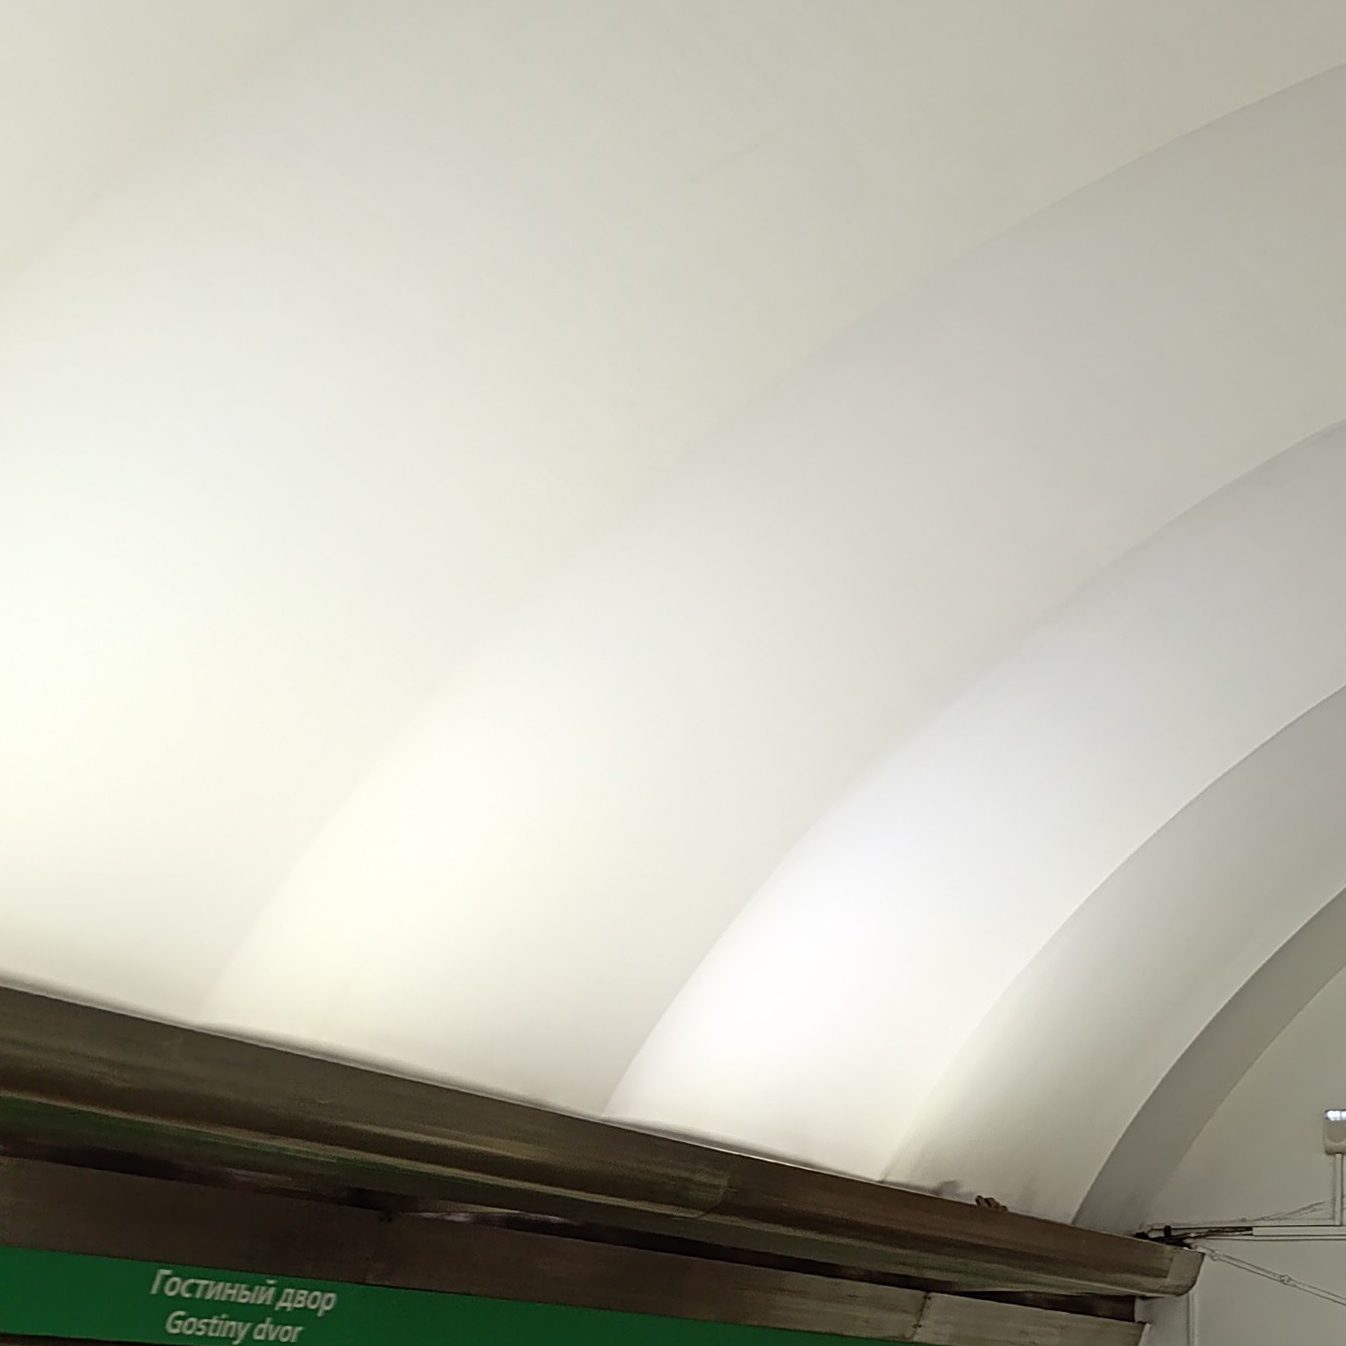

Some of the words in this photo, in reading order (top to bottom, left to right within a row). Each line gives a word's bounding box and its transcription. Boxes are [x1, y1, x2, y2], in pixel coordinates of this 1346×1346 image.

[150, 1269, 278, 1305] Гостиный
[275, 1288, 337, 1317] двор
[165, 1310, 253, 1345] Gostiny
[253, 1317, 304, 1343] dvor
